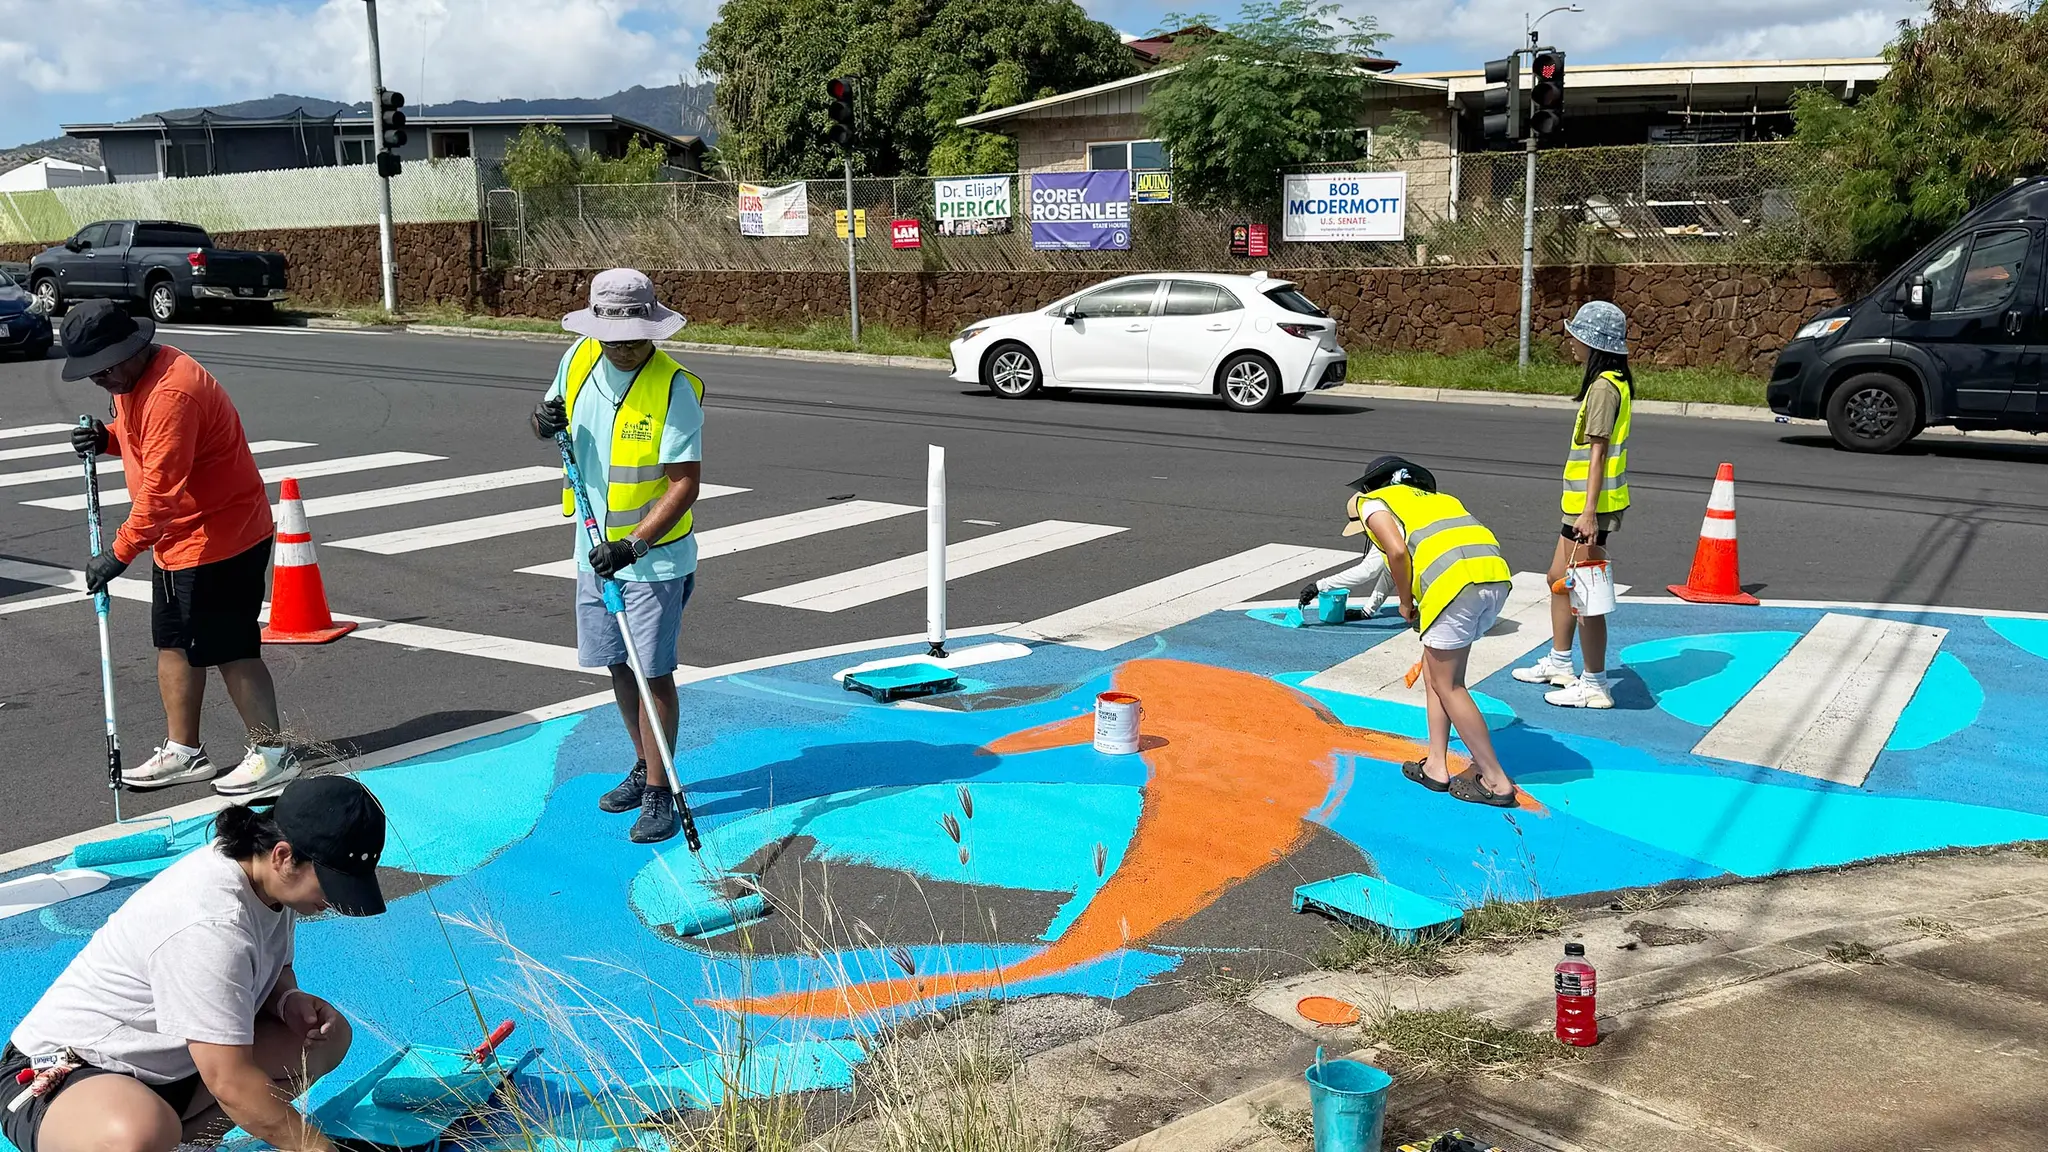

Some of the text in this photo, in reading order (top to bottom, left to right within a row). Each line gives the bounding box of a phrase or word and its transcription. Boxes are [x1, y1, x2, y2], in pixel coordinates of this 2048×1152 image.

[1138, 174, 1170, 190] AQUINO
[1329, 183, 1359, 196] BOB
[943, 182, 1002, 199] Dr. Elijah
[1032, 188, 1088, 204] COREY
[940, 199, 1008, 218] PIERICK
[1033, 202, 1128, 220] ROSENLEE
[1289, 198, 1399, 215] MCDERMOTT
[1320, 217, 1367, 225] U.S. SENATE
[893, 227, 920, 239] LAM
